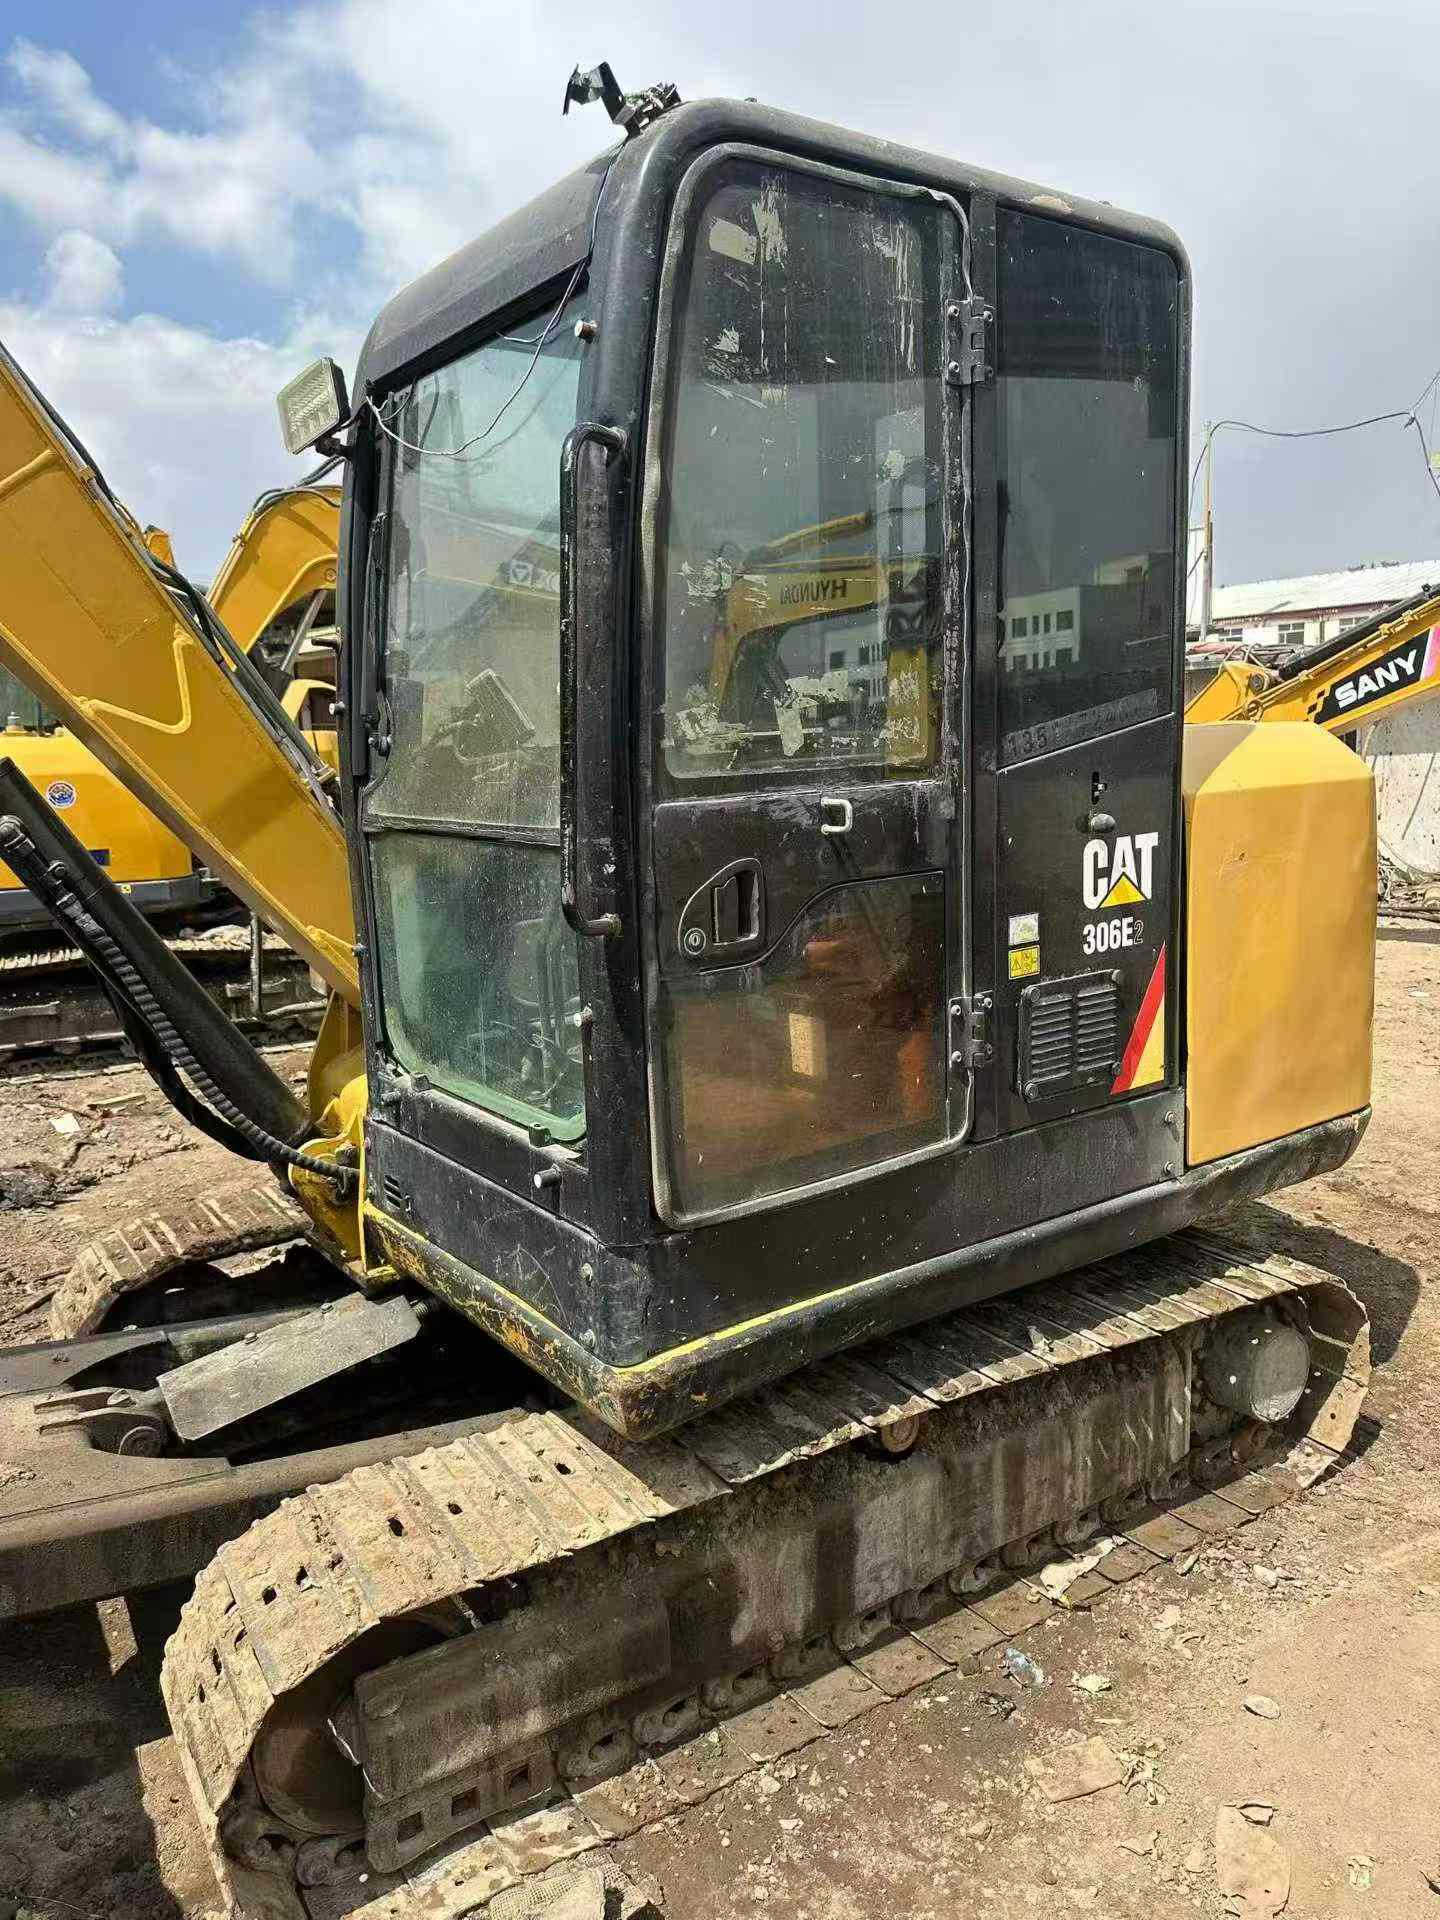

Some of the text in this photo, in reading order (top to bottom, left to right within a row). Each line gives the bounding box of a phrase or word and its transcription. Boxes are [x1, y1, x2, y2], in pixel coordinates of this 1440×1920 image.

[1334, 649, 1417, 709] SANY
[1082, 832, 1159, 910] CAT
[1082, 916, 1144, 955] 306E2
